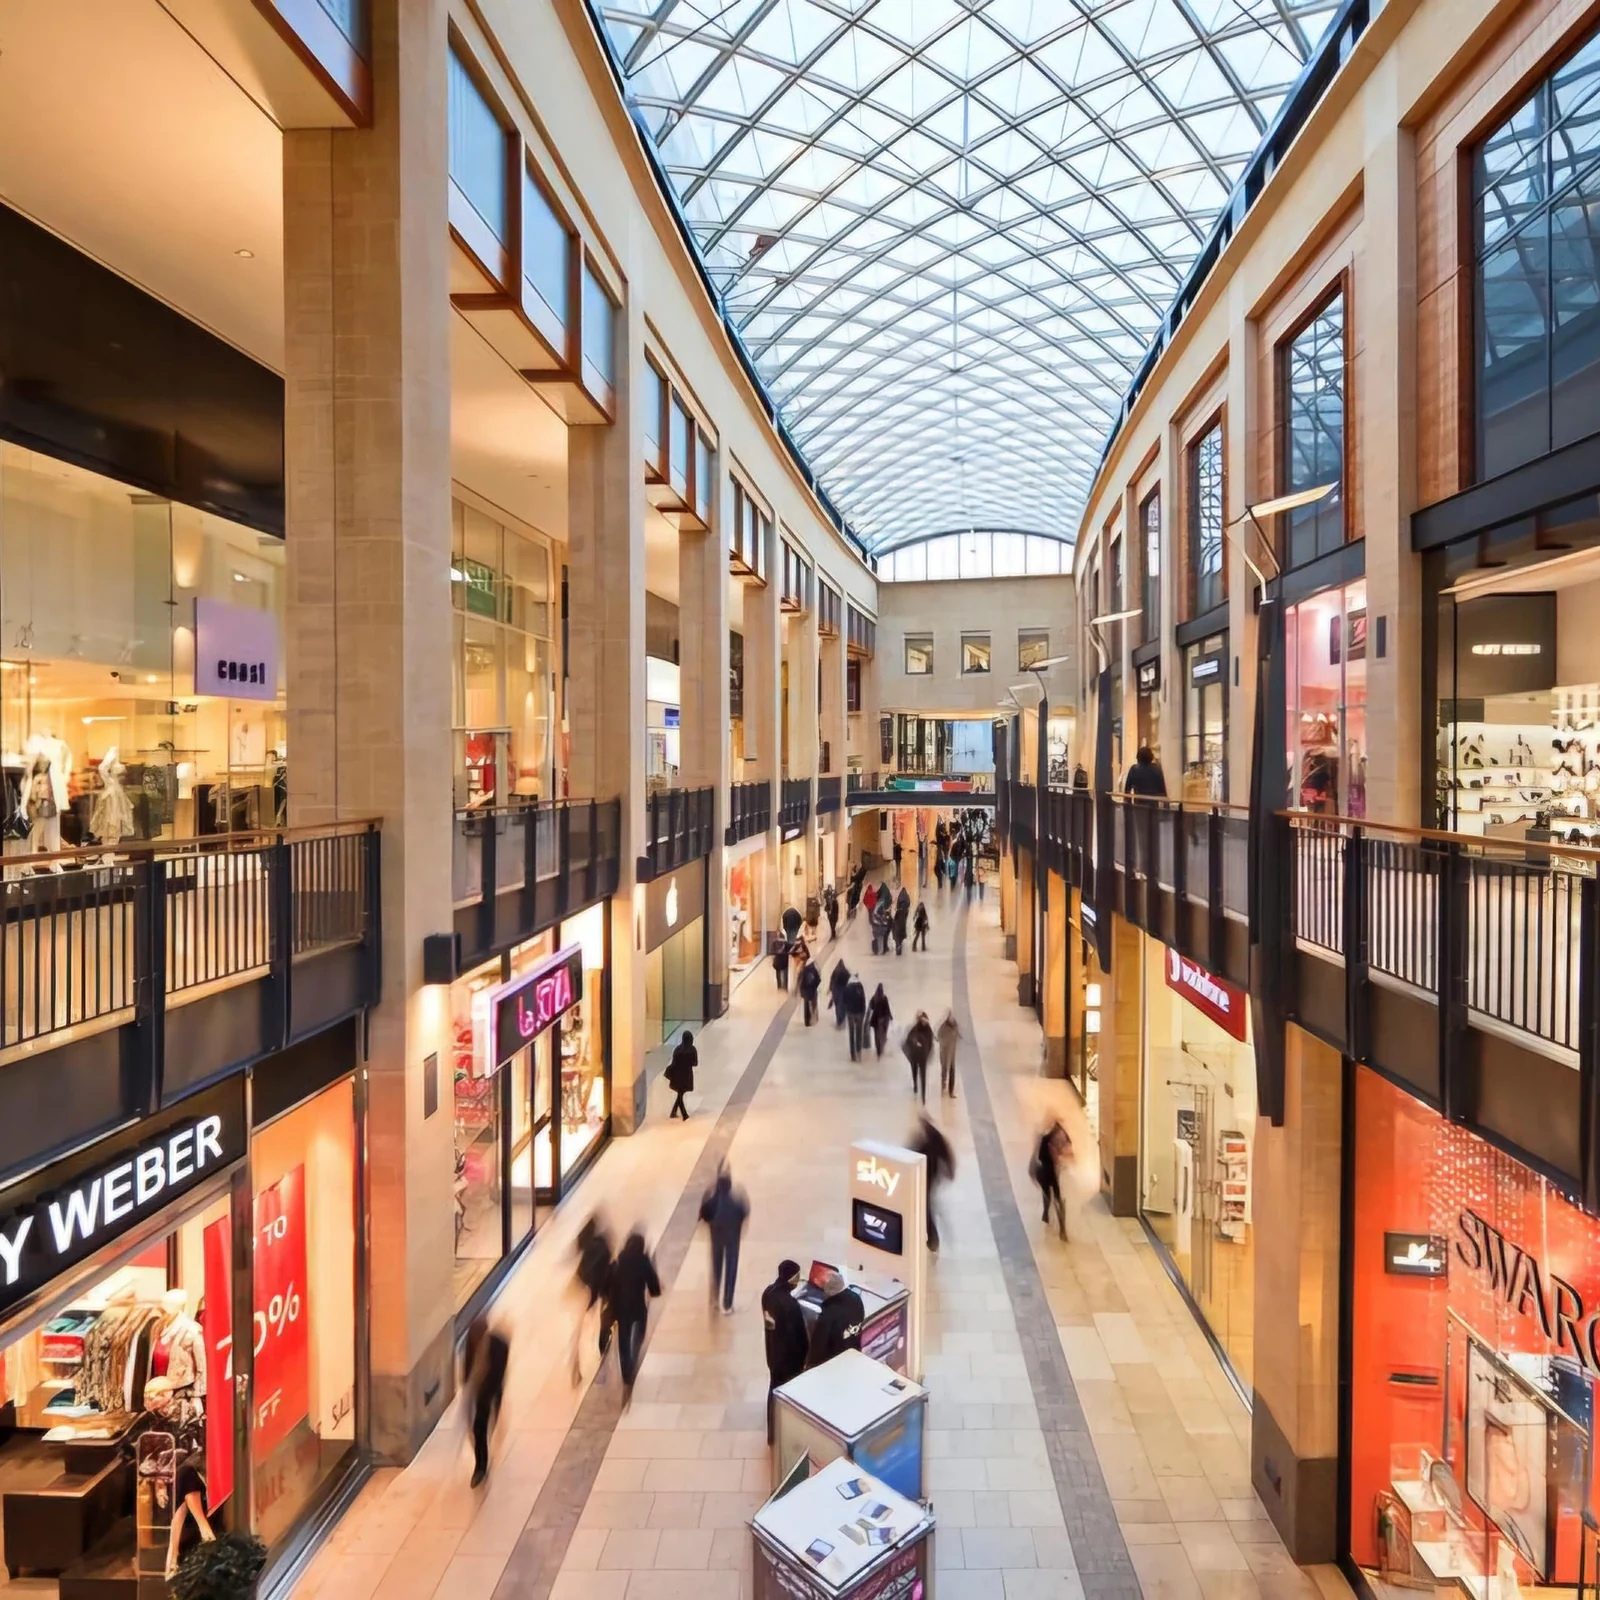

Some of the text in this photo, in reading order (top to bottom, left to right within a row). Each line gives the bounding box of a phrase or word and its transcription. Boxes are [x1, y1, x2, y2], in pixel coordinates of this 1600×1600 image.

[48, 1115, 224, 1254] WEBER
[856, 1155, 901, 1197] sky
[262, 1215, 288, 1247] TO
[253, 1388, 283, 1429] FF
